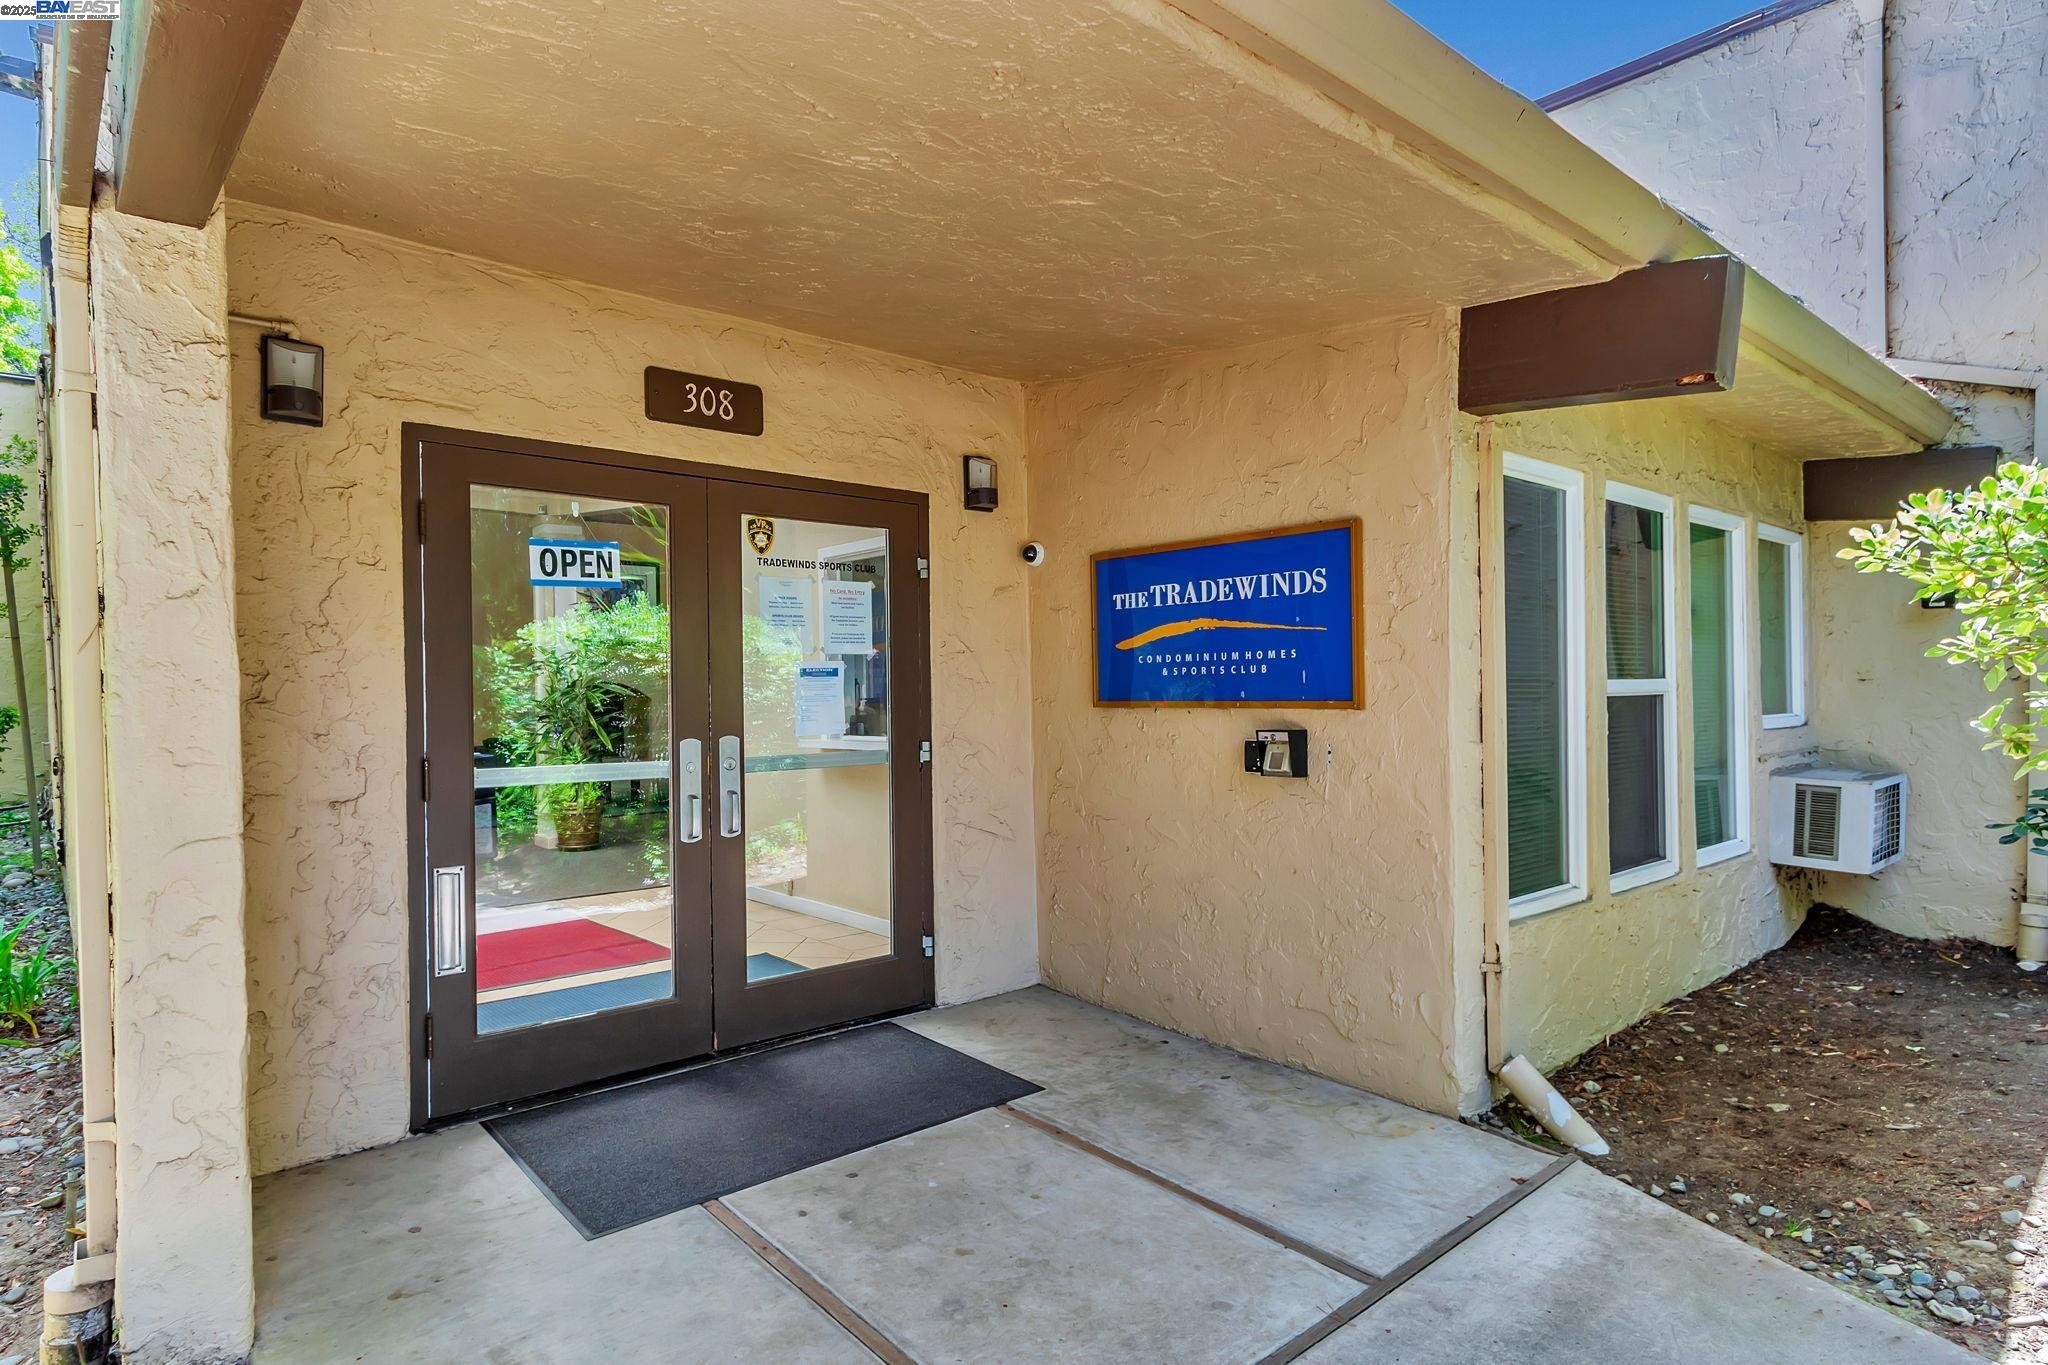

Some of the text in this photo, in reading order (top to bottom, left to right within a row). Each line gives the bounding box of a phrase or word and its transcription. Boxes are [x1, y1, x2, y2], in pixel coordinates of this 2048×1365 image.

[682, 382, 735, 421] 308
[539, 547, 614, 579] OPEN
[756, 557, 877, 574] TRADEWINDS SPORTS CLUB
[1112, 567, 1328, 610] THE TRADEWINDS
[1138, 648, 1297, 664] CONDOMINIUM HOMES
[1162, 667, 1169, 676] &
